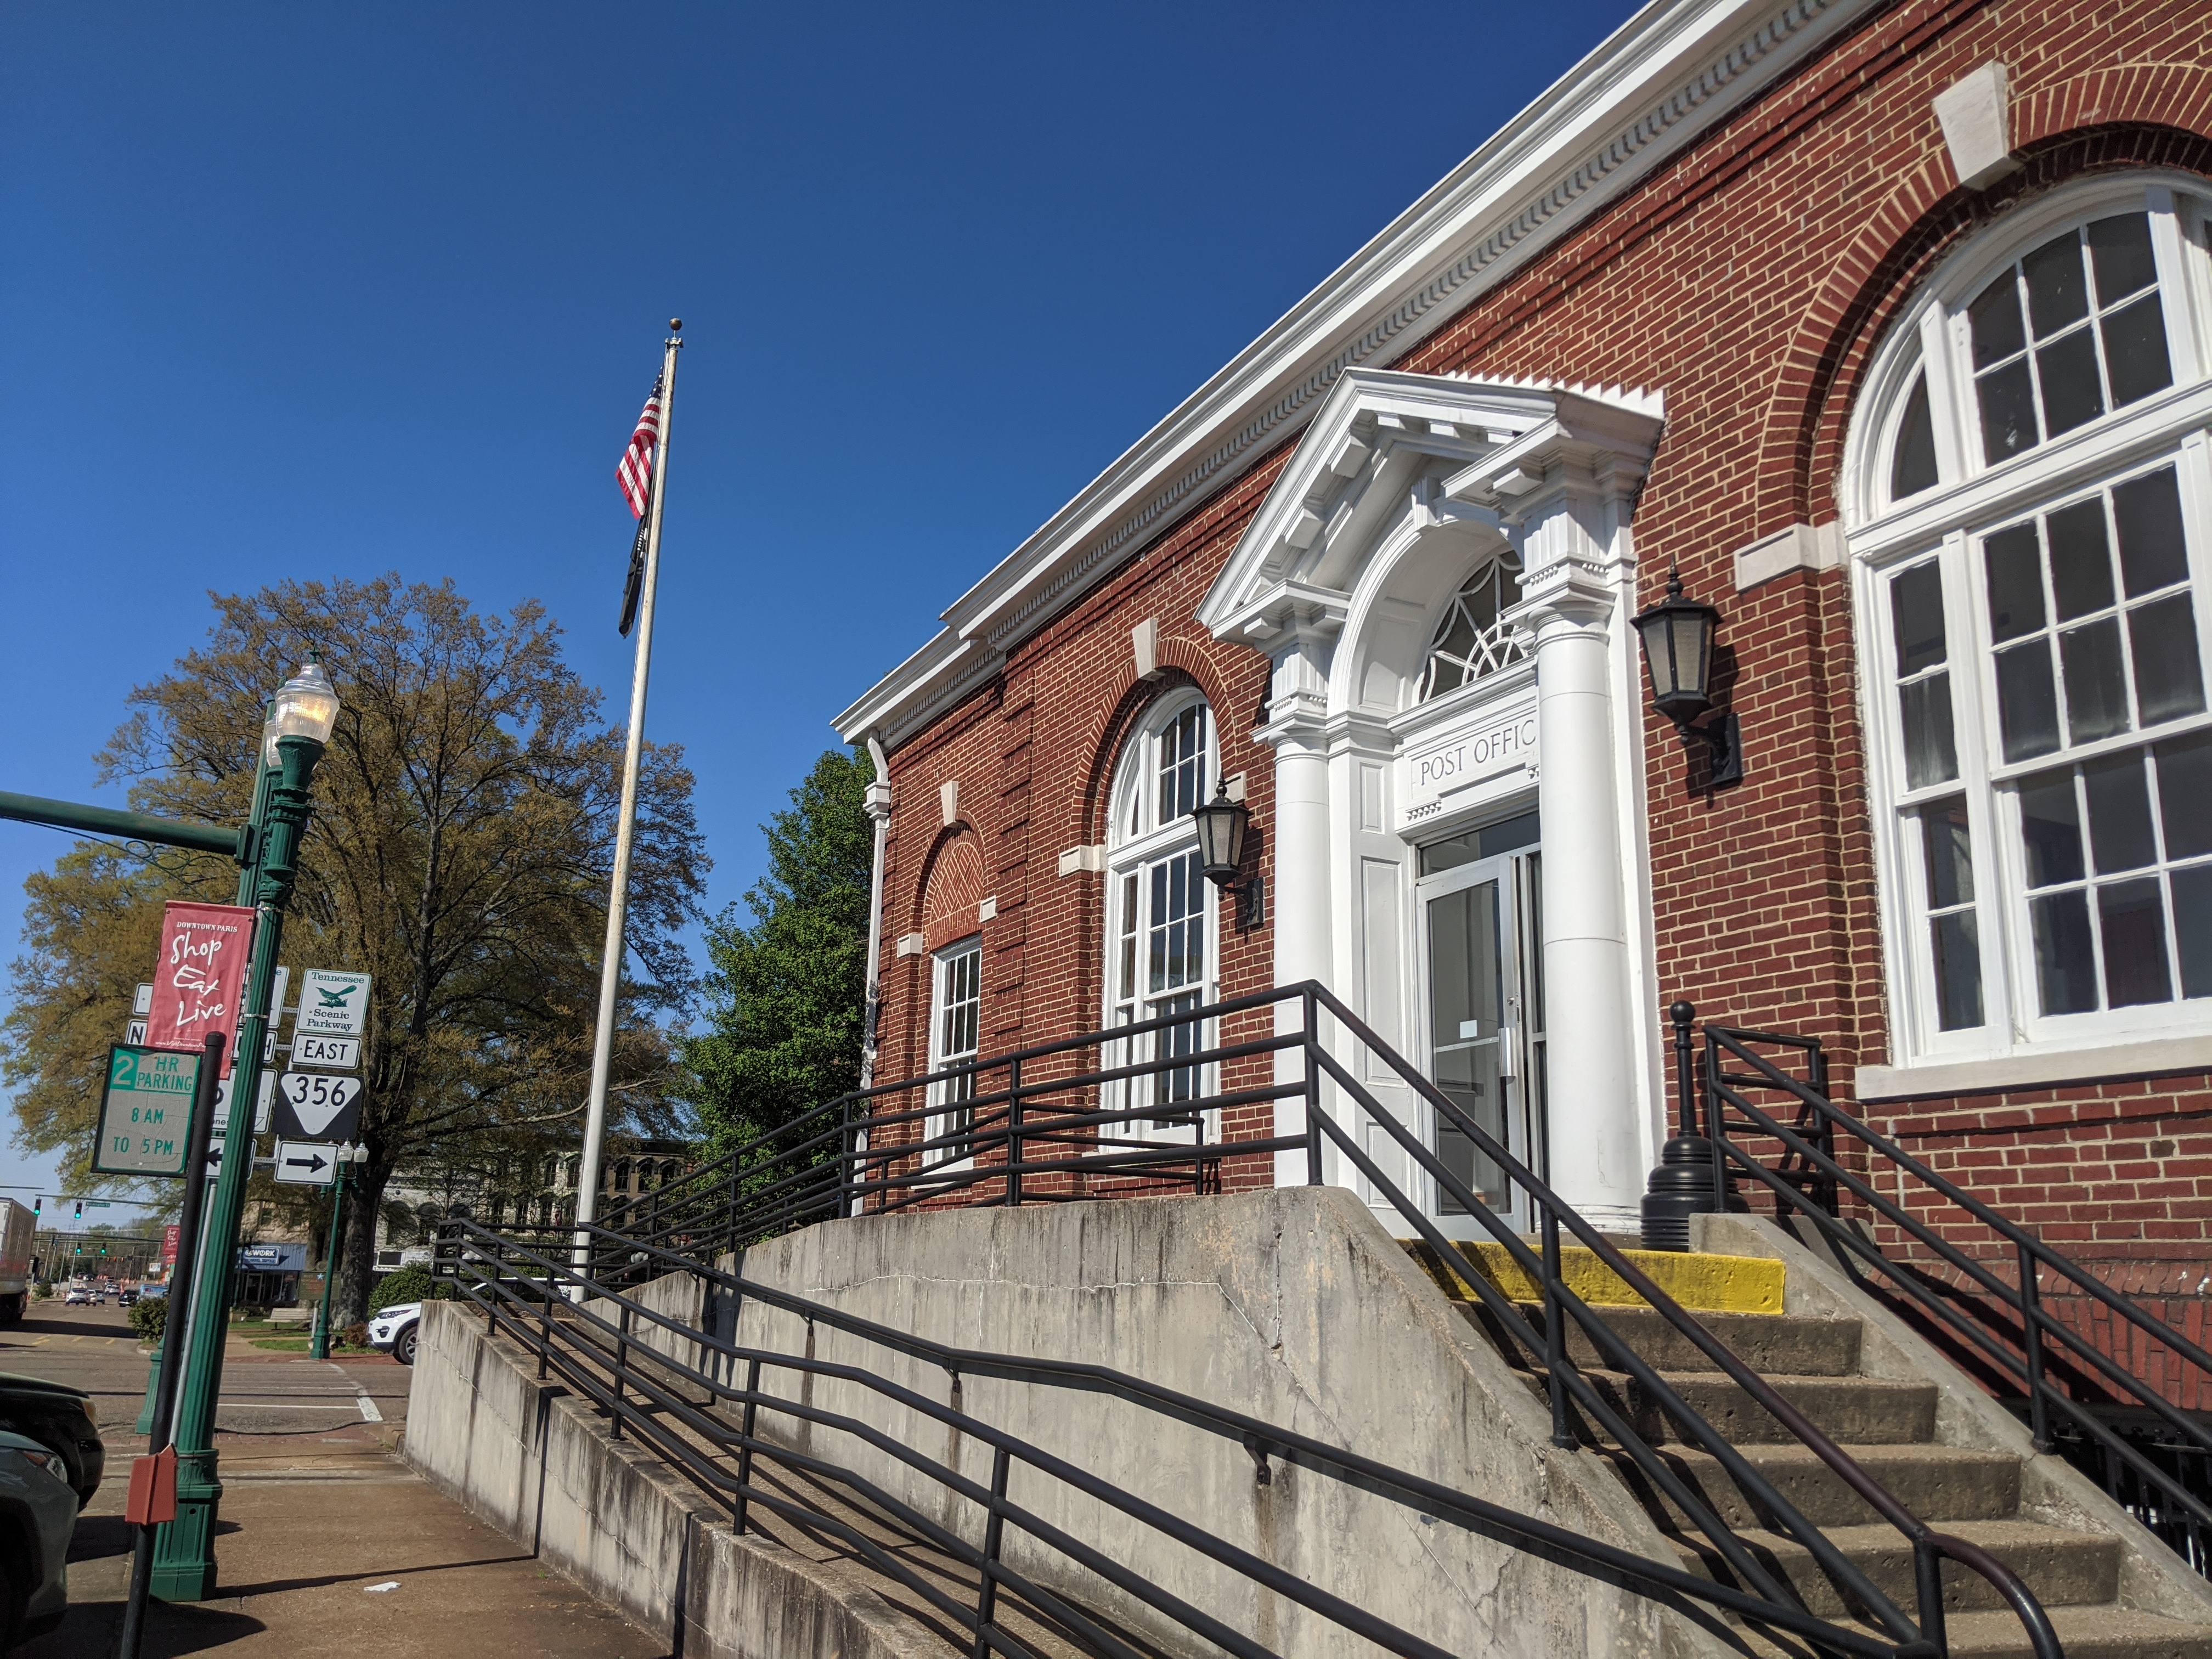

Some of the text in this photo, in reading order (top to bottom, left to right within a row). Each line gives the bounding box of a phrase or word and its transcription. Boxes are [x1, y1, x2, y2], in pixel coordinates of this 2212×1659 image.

[1420, 719, 1537, 786] POST OFFIC
[177, 921, 216, 931] DOWNTOWN
[170, 931, 222, 966] Shop
[173, 964, 221, 996] Eat
[312, 972, 365, 984] Tennessee
[177, 1000, 227, 1026] Live
[313, 1008, 349, 1019] Scenic
[306, 1018, 354, 1031] Parkway
[303, 1040, 348, 1061] EAST
[113, 1055, 179, 1085] 2 HR
[137, 1072, 192, 1091] PARKING
[292, 1076, 347, 1107] 356
[131, 1107, 164, 1124] 8 AM
[114, 1136, 173, 1155] TO 5 PM
